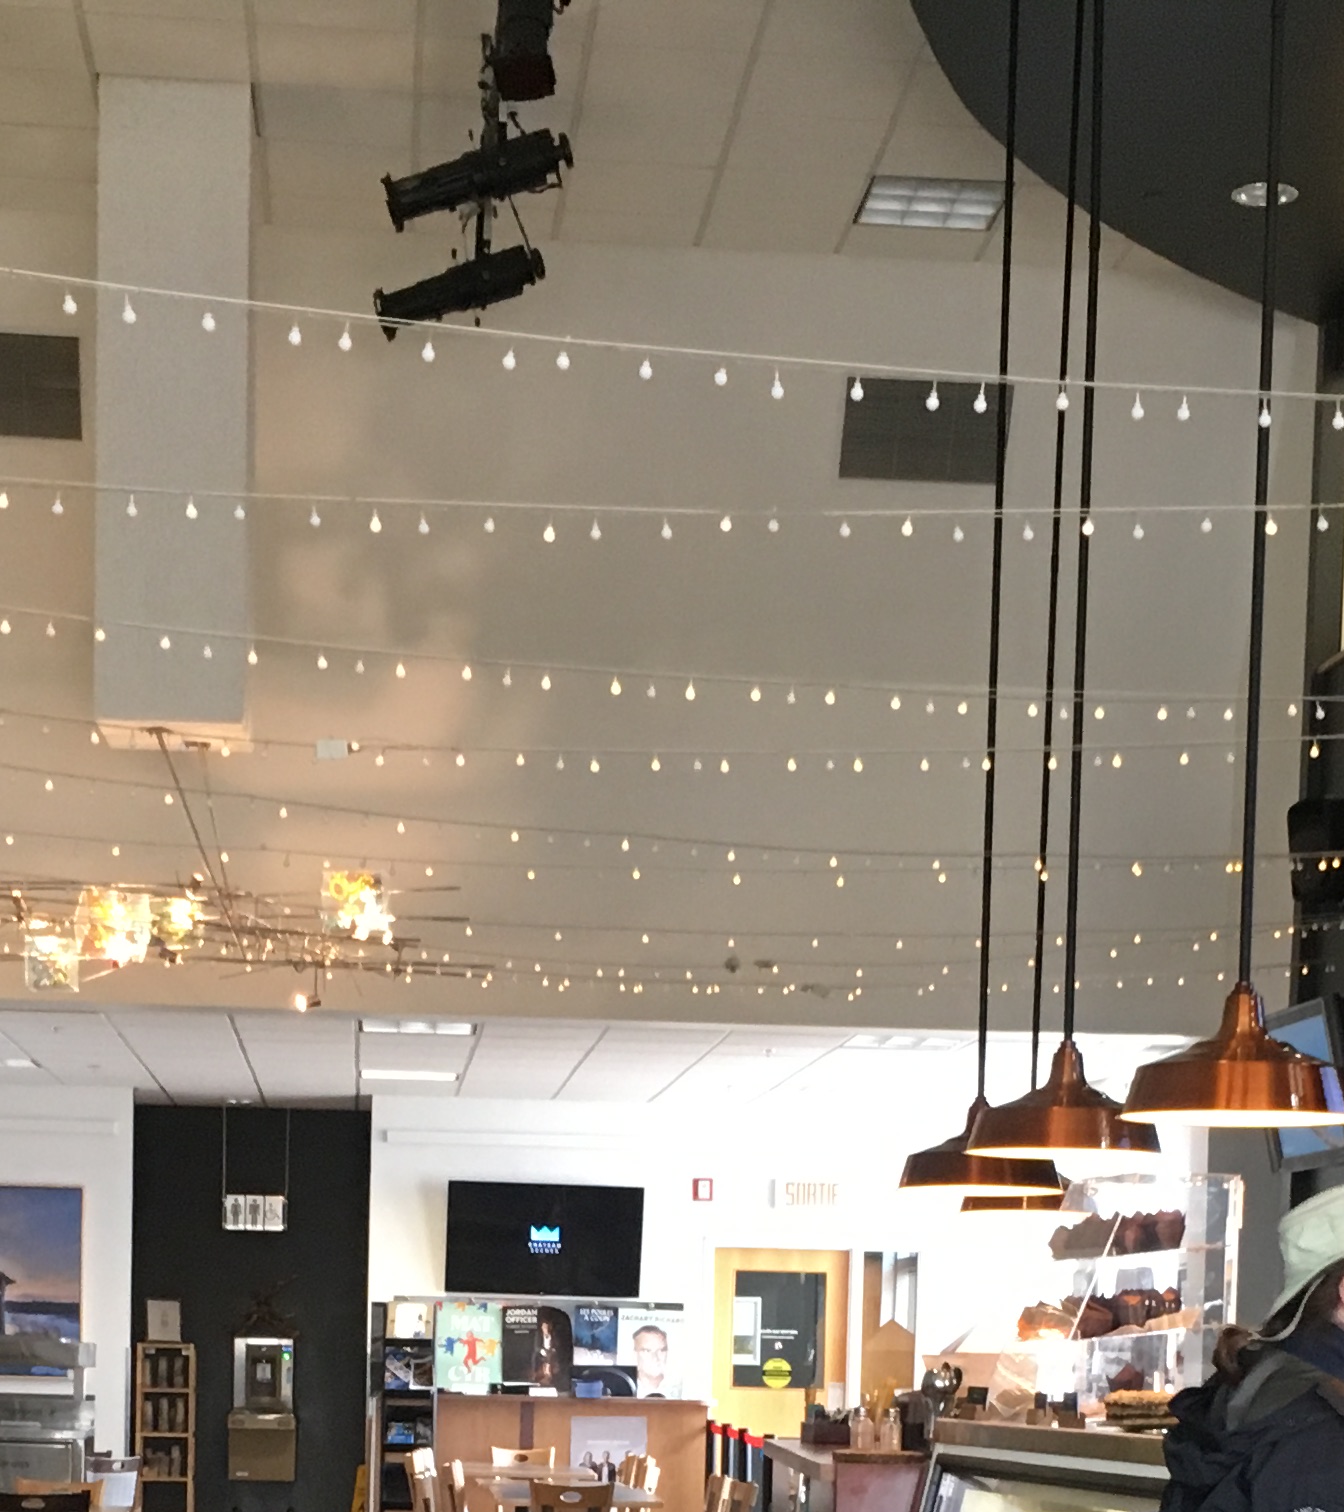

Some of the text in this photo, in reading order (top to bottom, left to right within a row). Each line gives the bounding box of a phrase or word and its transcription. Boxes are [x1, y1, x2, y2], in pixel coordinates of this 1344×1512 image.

[784, 1181, 840, 1206] SORTIE
[506, 1308, 538, 1317] JORDAN
[504, 1316, 538, 1324] OFFICER
